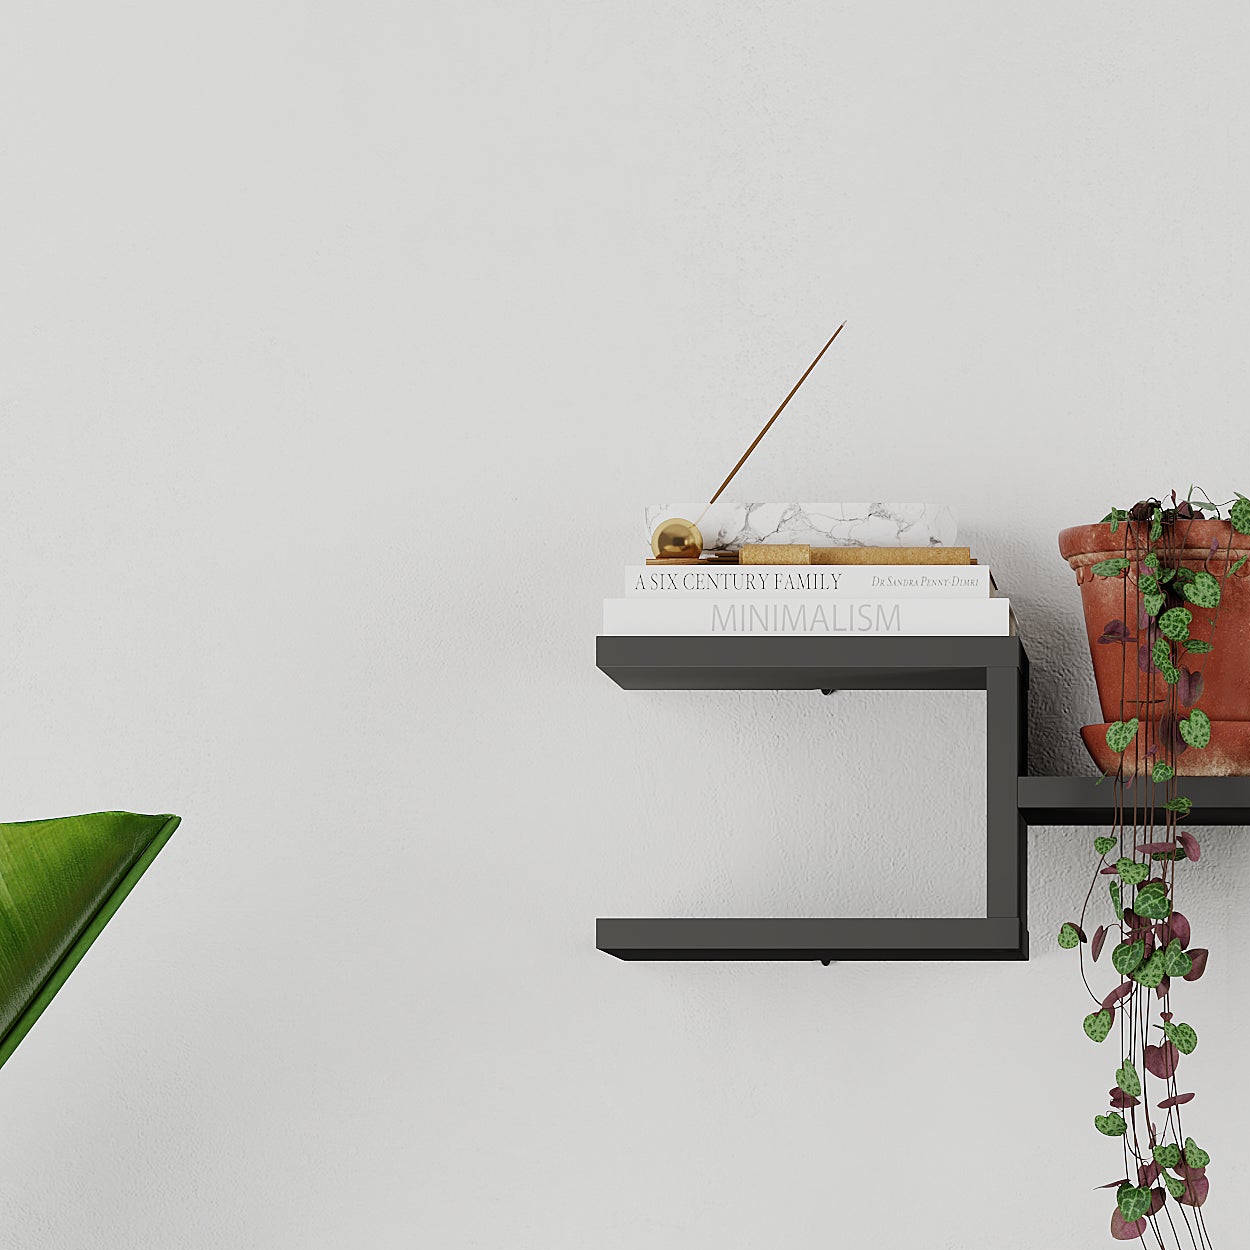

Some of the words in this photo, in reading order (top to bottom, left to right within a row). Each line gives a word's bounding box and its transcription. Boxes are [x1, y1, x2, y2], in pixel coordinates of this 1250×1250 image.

[635, 573, 646, 590] A
[650, 573, 678, 590] SIX
[683, 573, 769, 590] CENTURY
[774, 573, 842, 590] FAMILY
[711, 604, 901, 632] MINIMALISM
